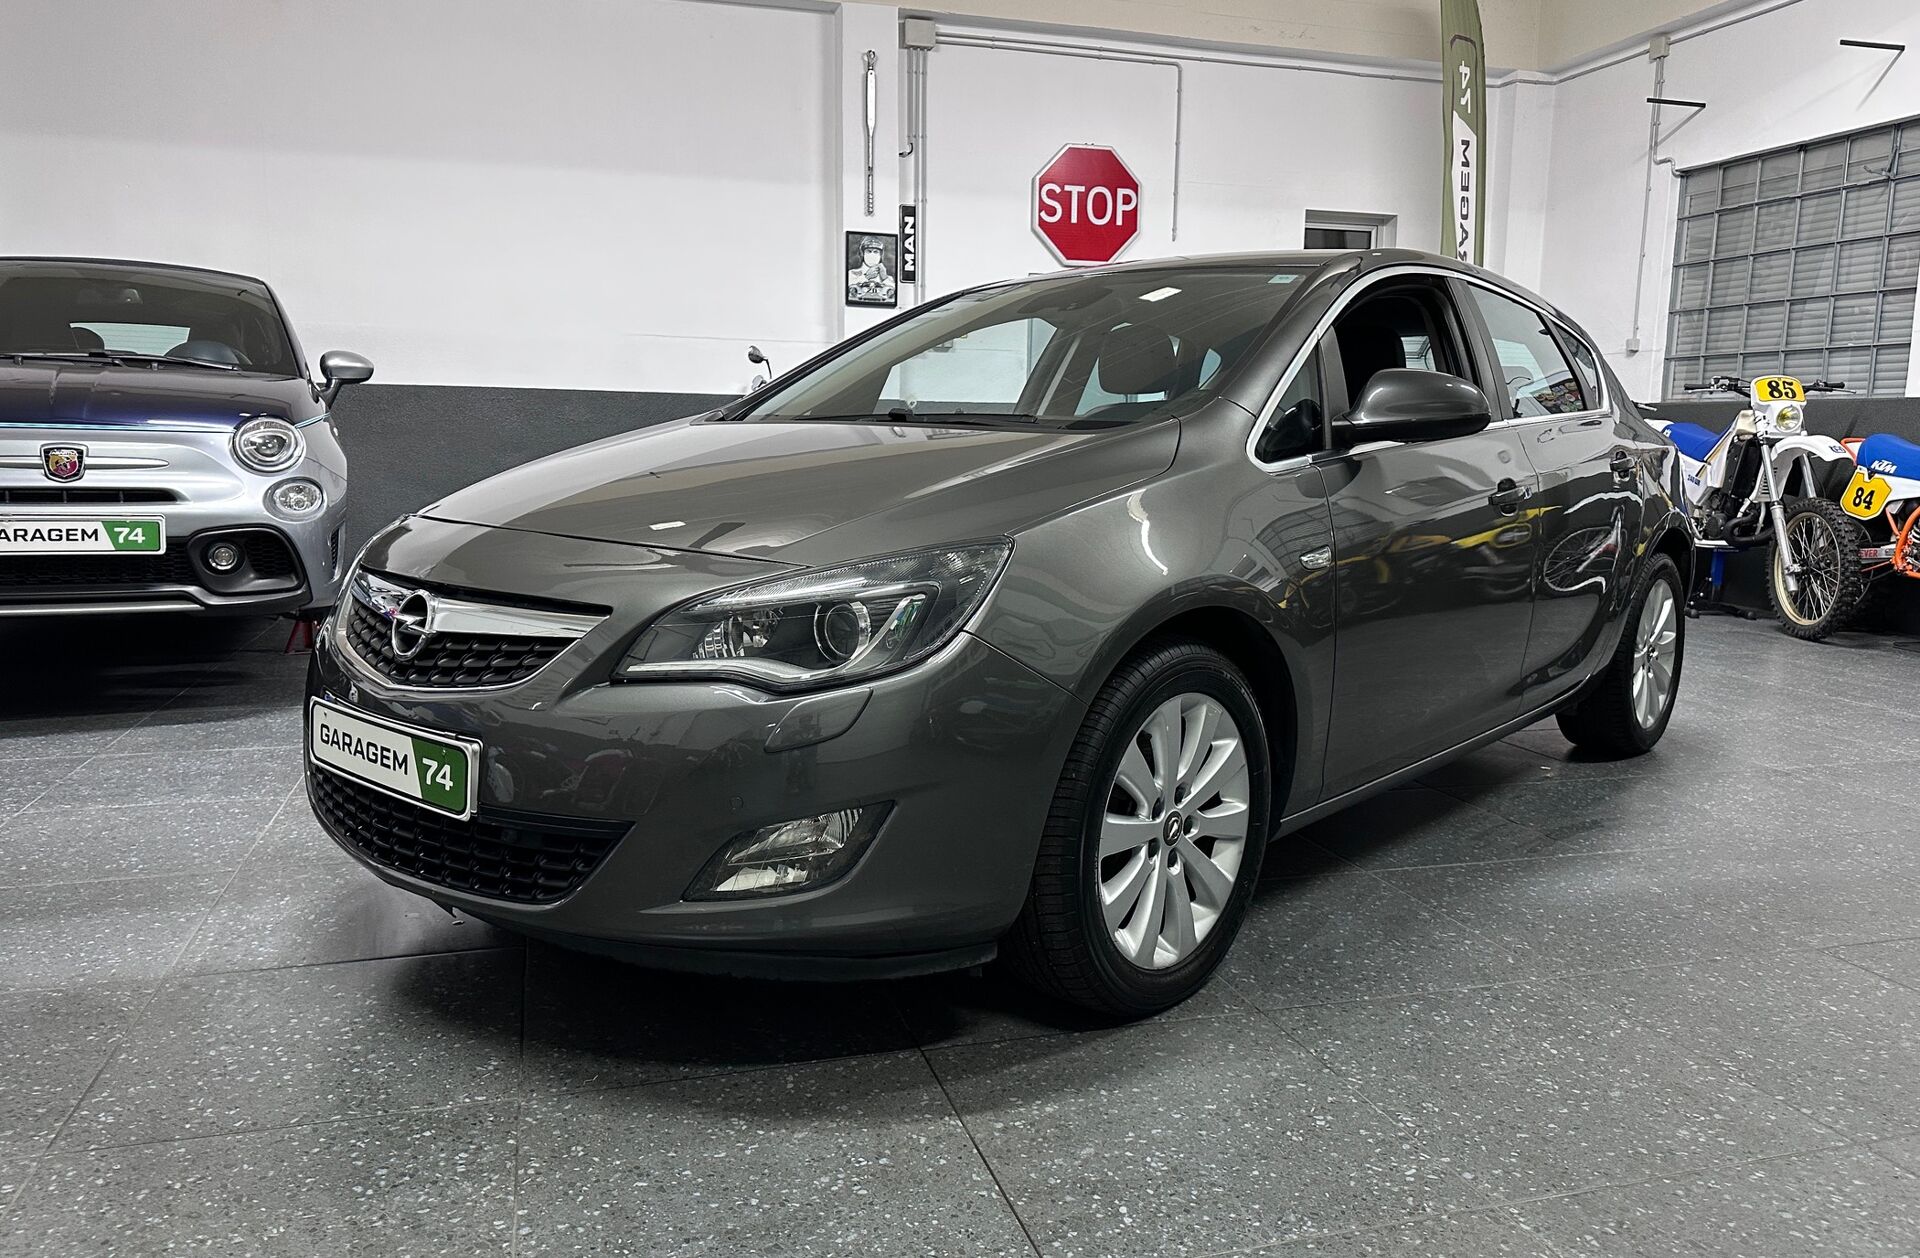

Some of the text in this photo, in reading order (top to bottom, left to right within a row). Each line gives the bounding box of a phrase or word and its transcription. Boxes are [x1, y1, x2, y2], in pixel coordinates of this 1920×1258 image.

[1039, 183, 1137, 226] STOP
[904, 216, 915, 271] MAN
[1767, 380, 1797, 400] 85
[1870, 459, 1898, 474] KTM
[1852, 487, 1876, 510] 84
[114, 527, 146, 544] 74
[320, 723, 454, 791] GARAGEM 74
